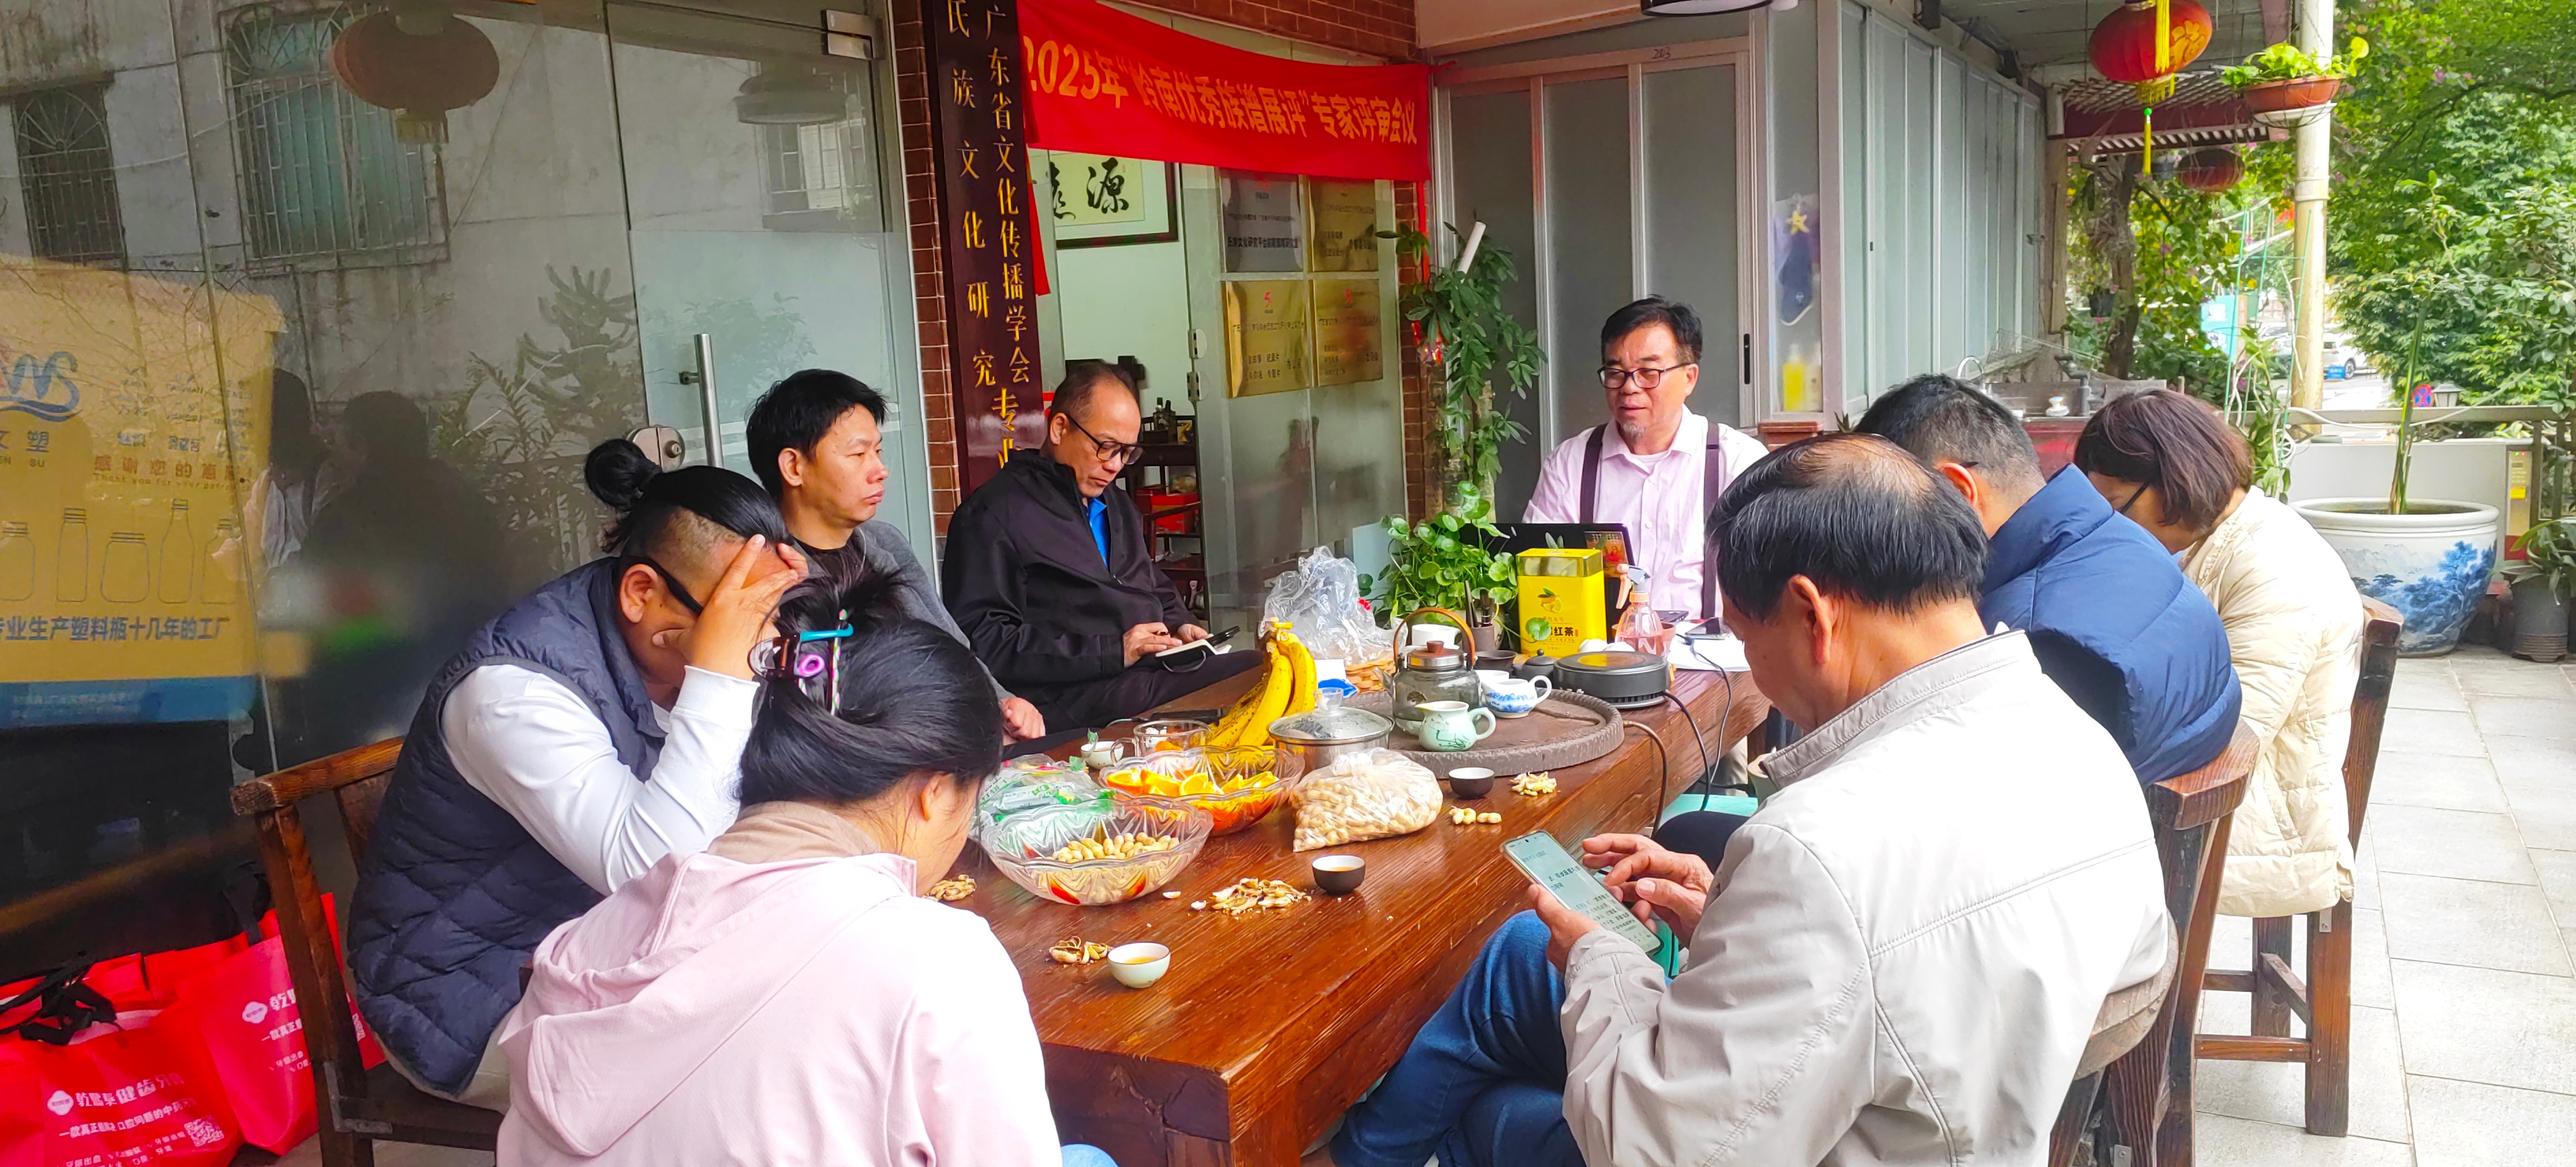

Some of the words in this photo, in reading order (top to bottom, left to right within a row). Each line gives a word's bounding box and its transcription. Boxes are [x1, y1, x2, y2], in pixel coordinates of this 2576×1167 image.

[1651, 47, 1671, 60] 203
[985, 4, 1030, 384] 广东省文化传播学会
[29, 458, 45, 468] SU
[1551, 626, 1574, 637] 红茶
